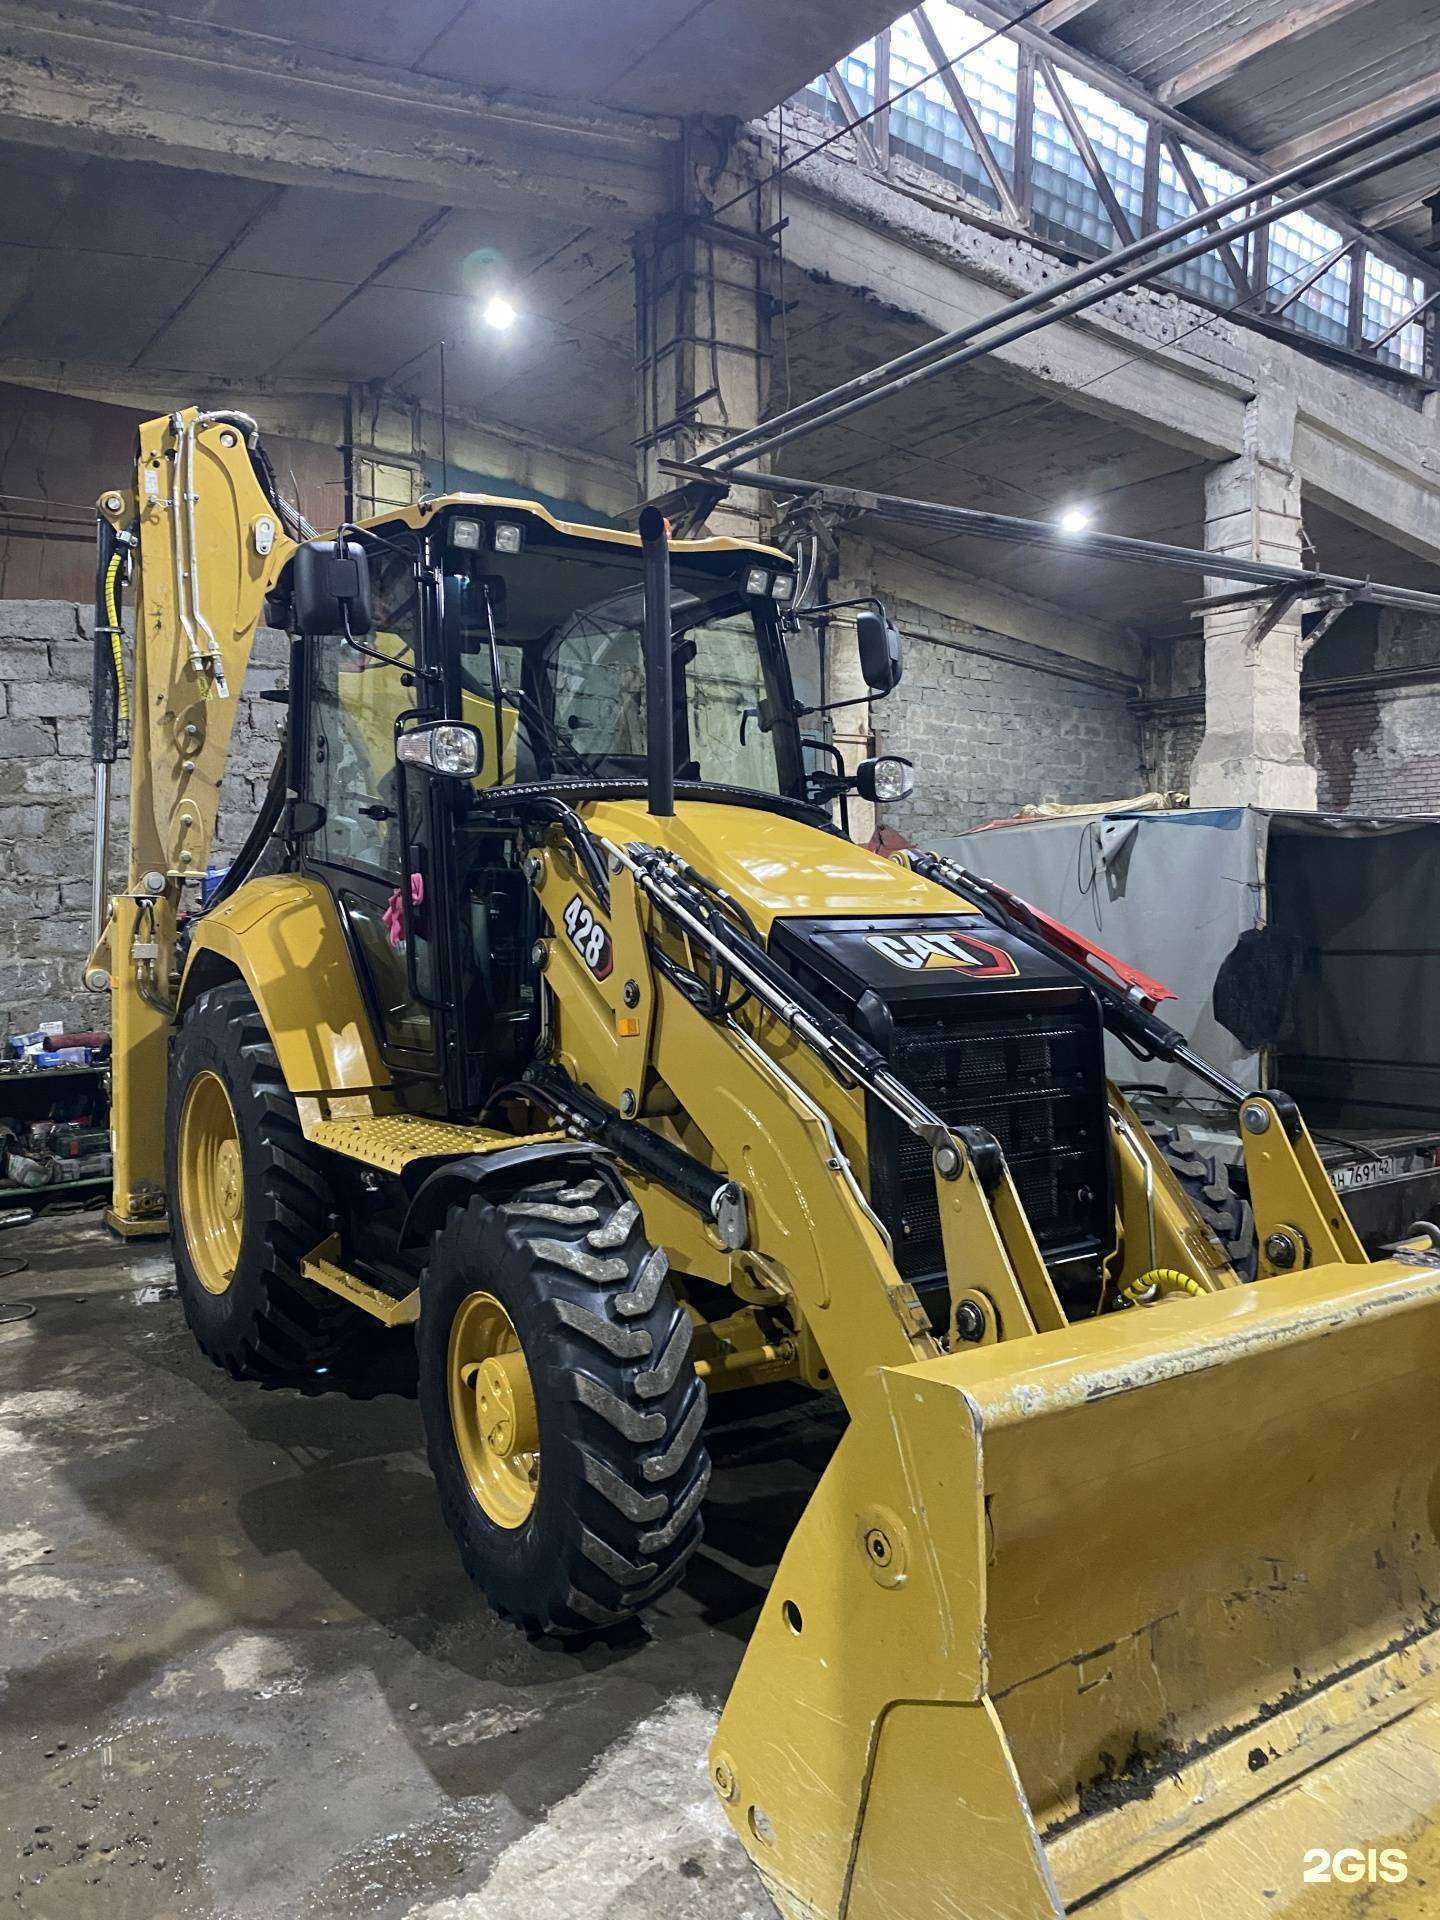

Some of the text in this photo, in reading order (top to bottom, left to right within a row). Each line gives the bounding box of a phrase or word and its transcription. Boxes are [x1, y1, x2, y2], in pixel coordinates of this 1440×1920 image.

[564, 896, 605, 968] 428
[865, 934, 984, 969] CAT
[1346, 1164, 1377, 1186] 7691
